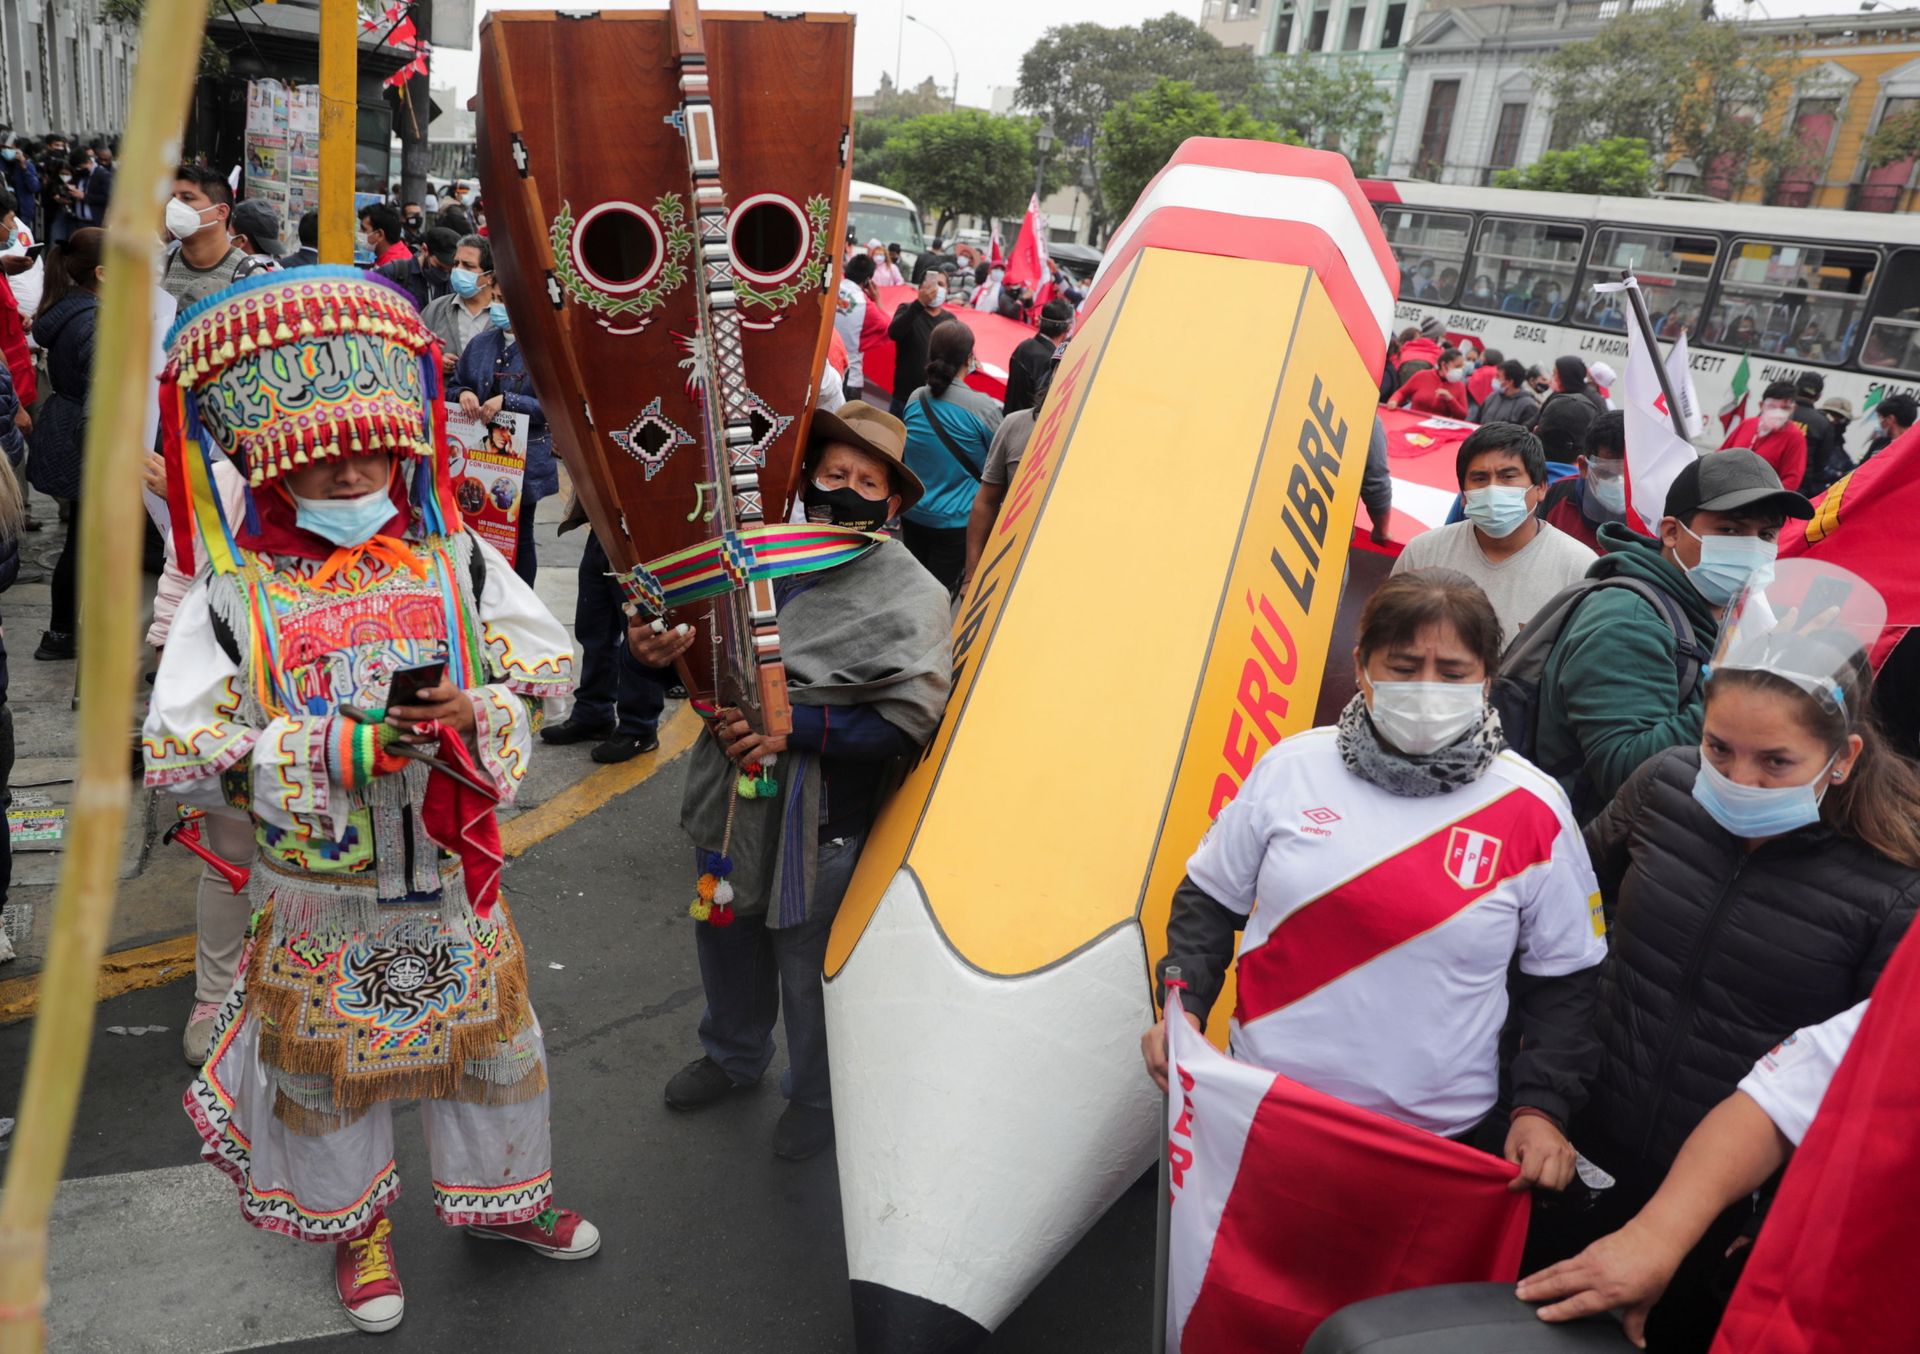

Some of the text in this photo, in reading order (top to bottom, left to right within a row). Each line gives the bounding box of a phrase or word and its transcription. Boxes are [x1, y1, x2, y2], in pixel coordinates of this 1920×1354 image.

[1447, 315, 1489, 333] ABANCAY
[1513, 325, 1548, 344] BRASIL
[1580, 335, 1594, 351] LA
[469, 450, 525, 469] VOLUNTARIO
[483, 463, 523, 477] UNIVERSIDAD
[1208, 373, 1348, 820] PERÚ LIBRE
[1300, 825, 1332, 837] umbro
